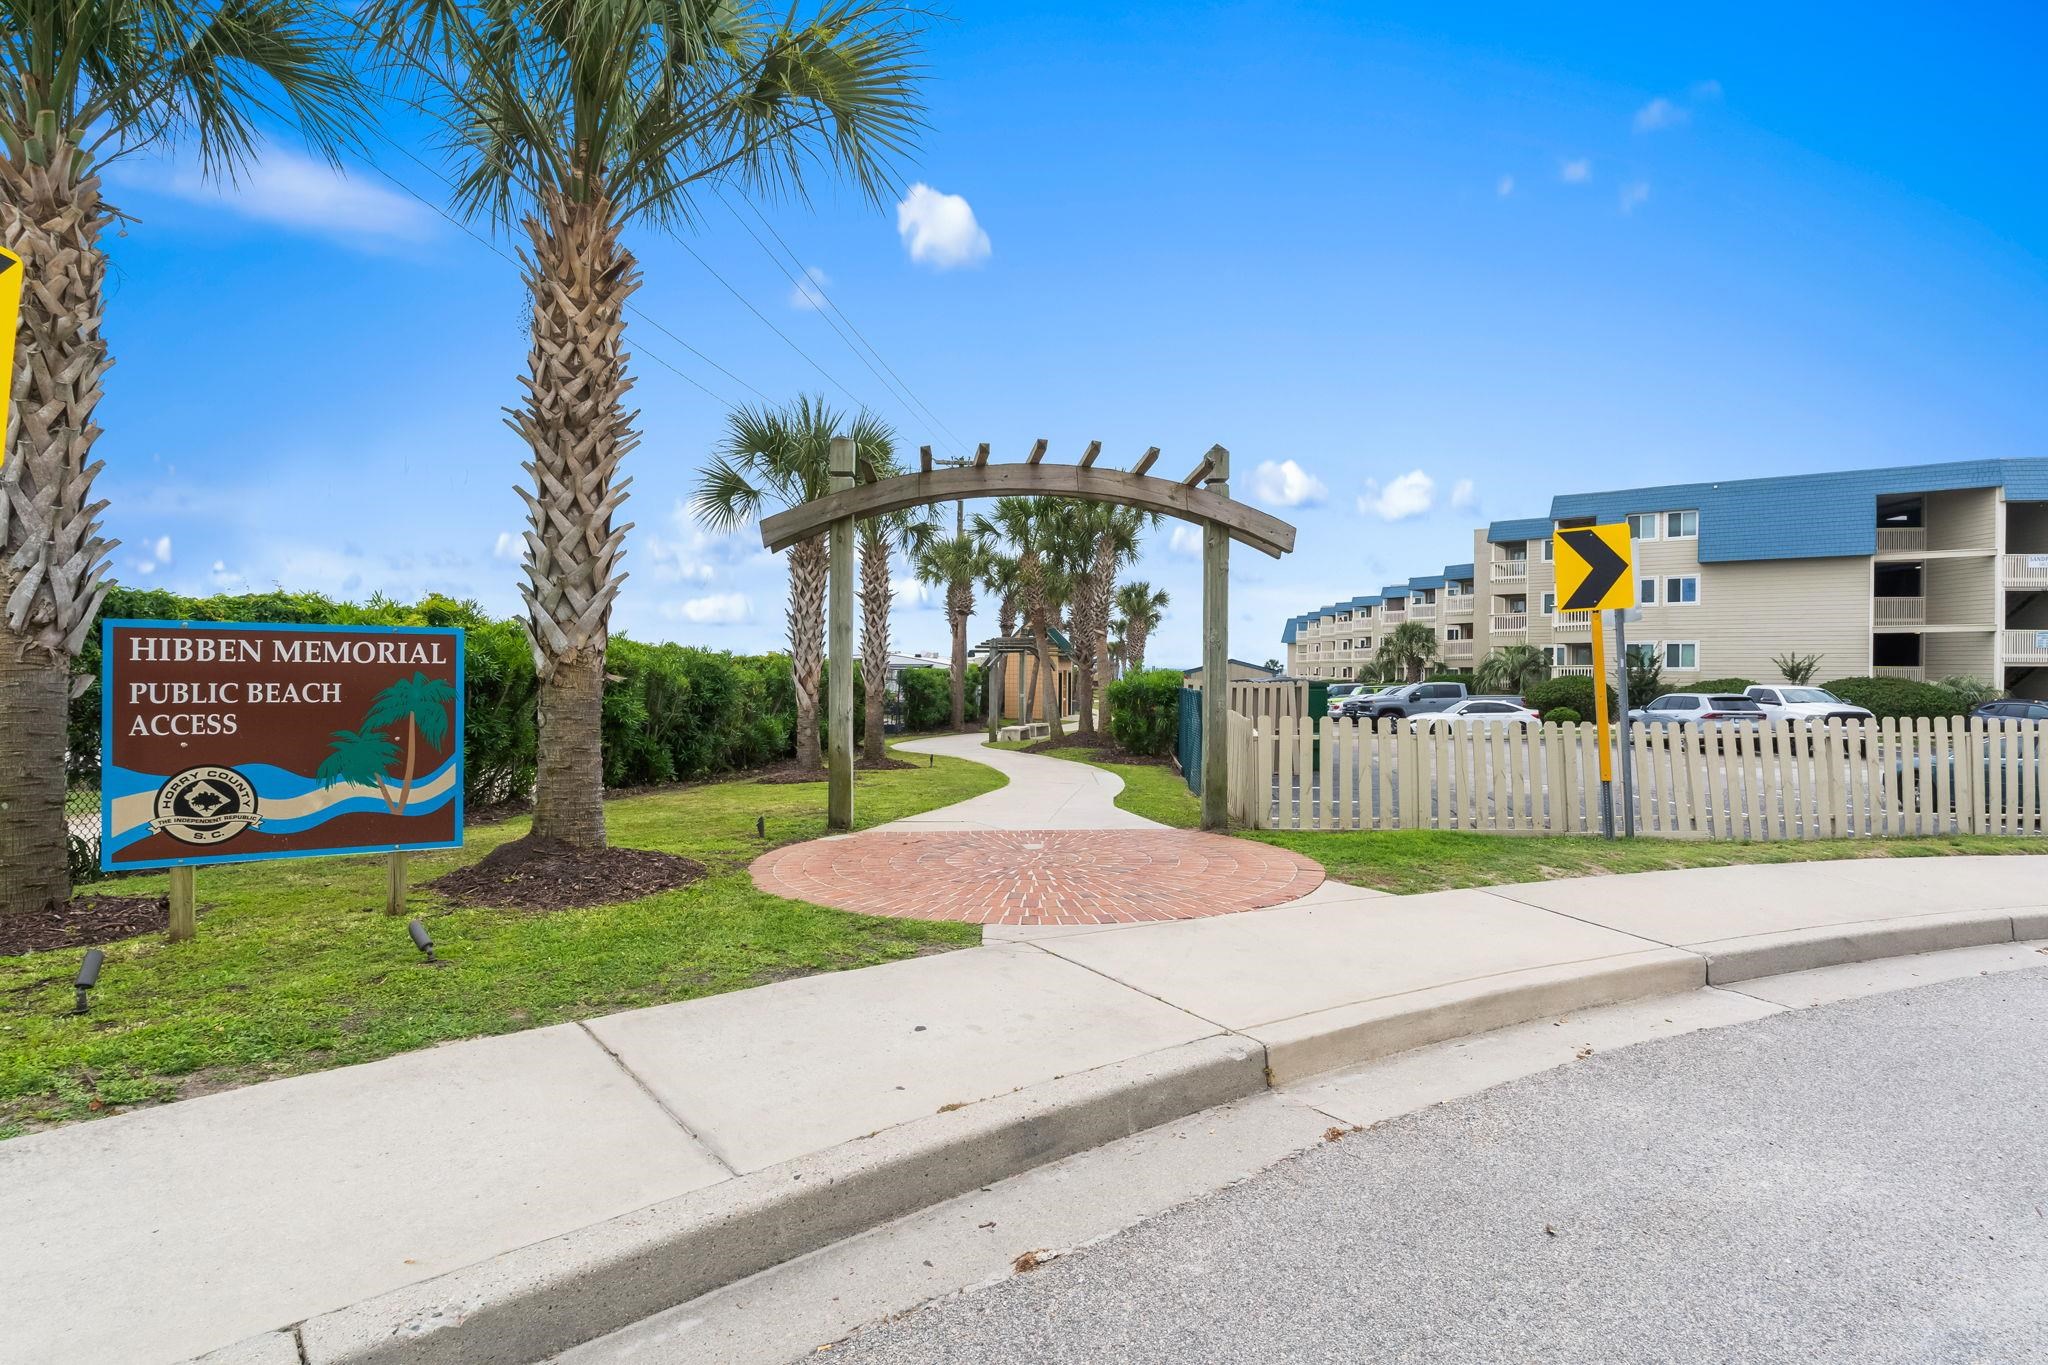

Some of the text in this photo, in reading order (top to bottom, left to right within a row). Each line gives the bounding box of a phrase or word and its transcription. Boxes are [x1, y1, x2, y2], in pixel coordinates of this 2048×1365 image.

[129, 637, 447, 665] HIBBEN MEMORIAL
[129, 682, 342, 704] PUBLIC BEACH
[128, 713, 239, 736] ACCESS
[162, 770, 251, 809] HORRY COUNTY
[193, 831, 225, 840] S. C.
